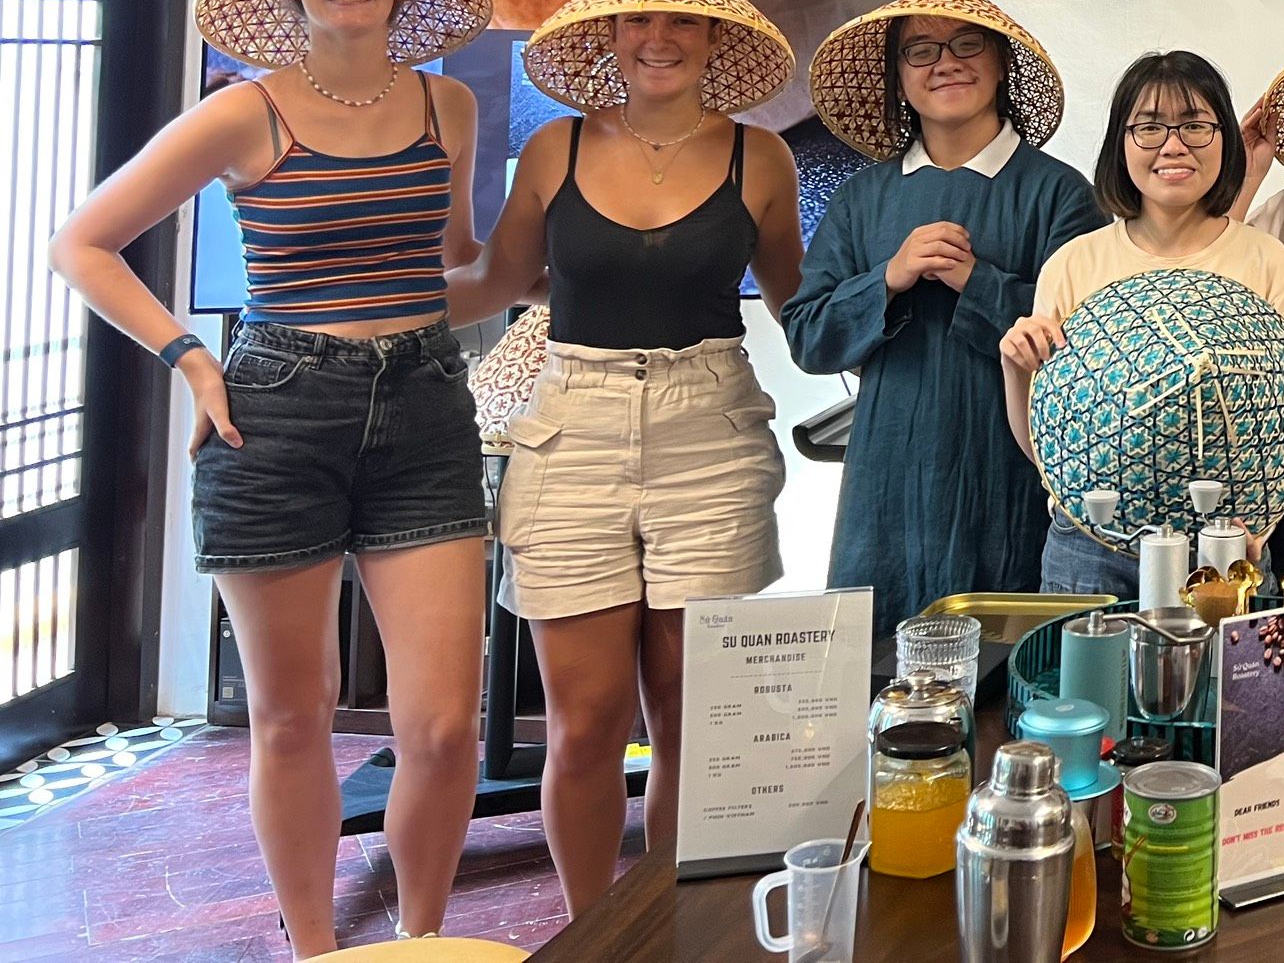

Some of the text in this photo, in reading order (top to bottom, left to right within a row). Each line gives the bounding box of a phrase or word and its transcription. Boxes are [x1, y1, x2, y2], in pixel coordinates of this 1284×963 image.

[722, 630, 835, 649] SU QUAN ROASTERY
[746, 652, 806, 665] MERCHANDISE
[754, 684, 792, 694] ROBUSTA
[753, 732, 791, 743] ARABICA
[751, 784, 784, 795] OTHERS
[1254, 799, 1280, 812] FRIENDS
